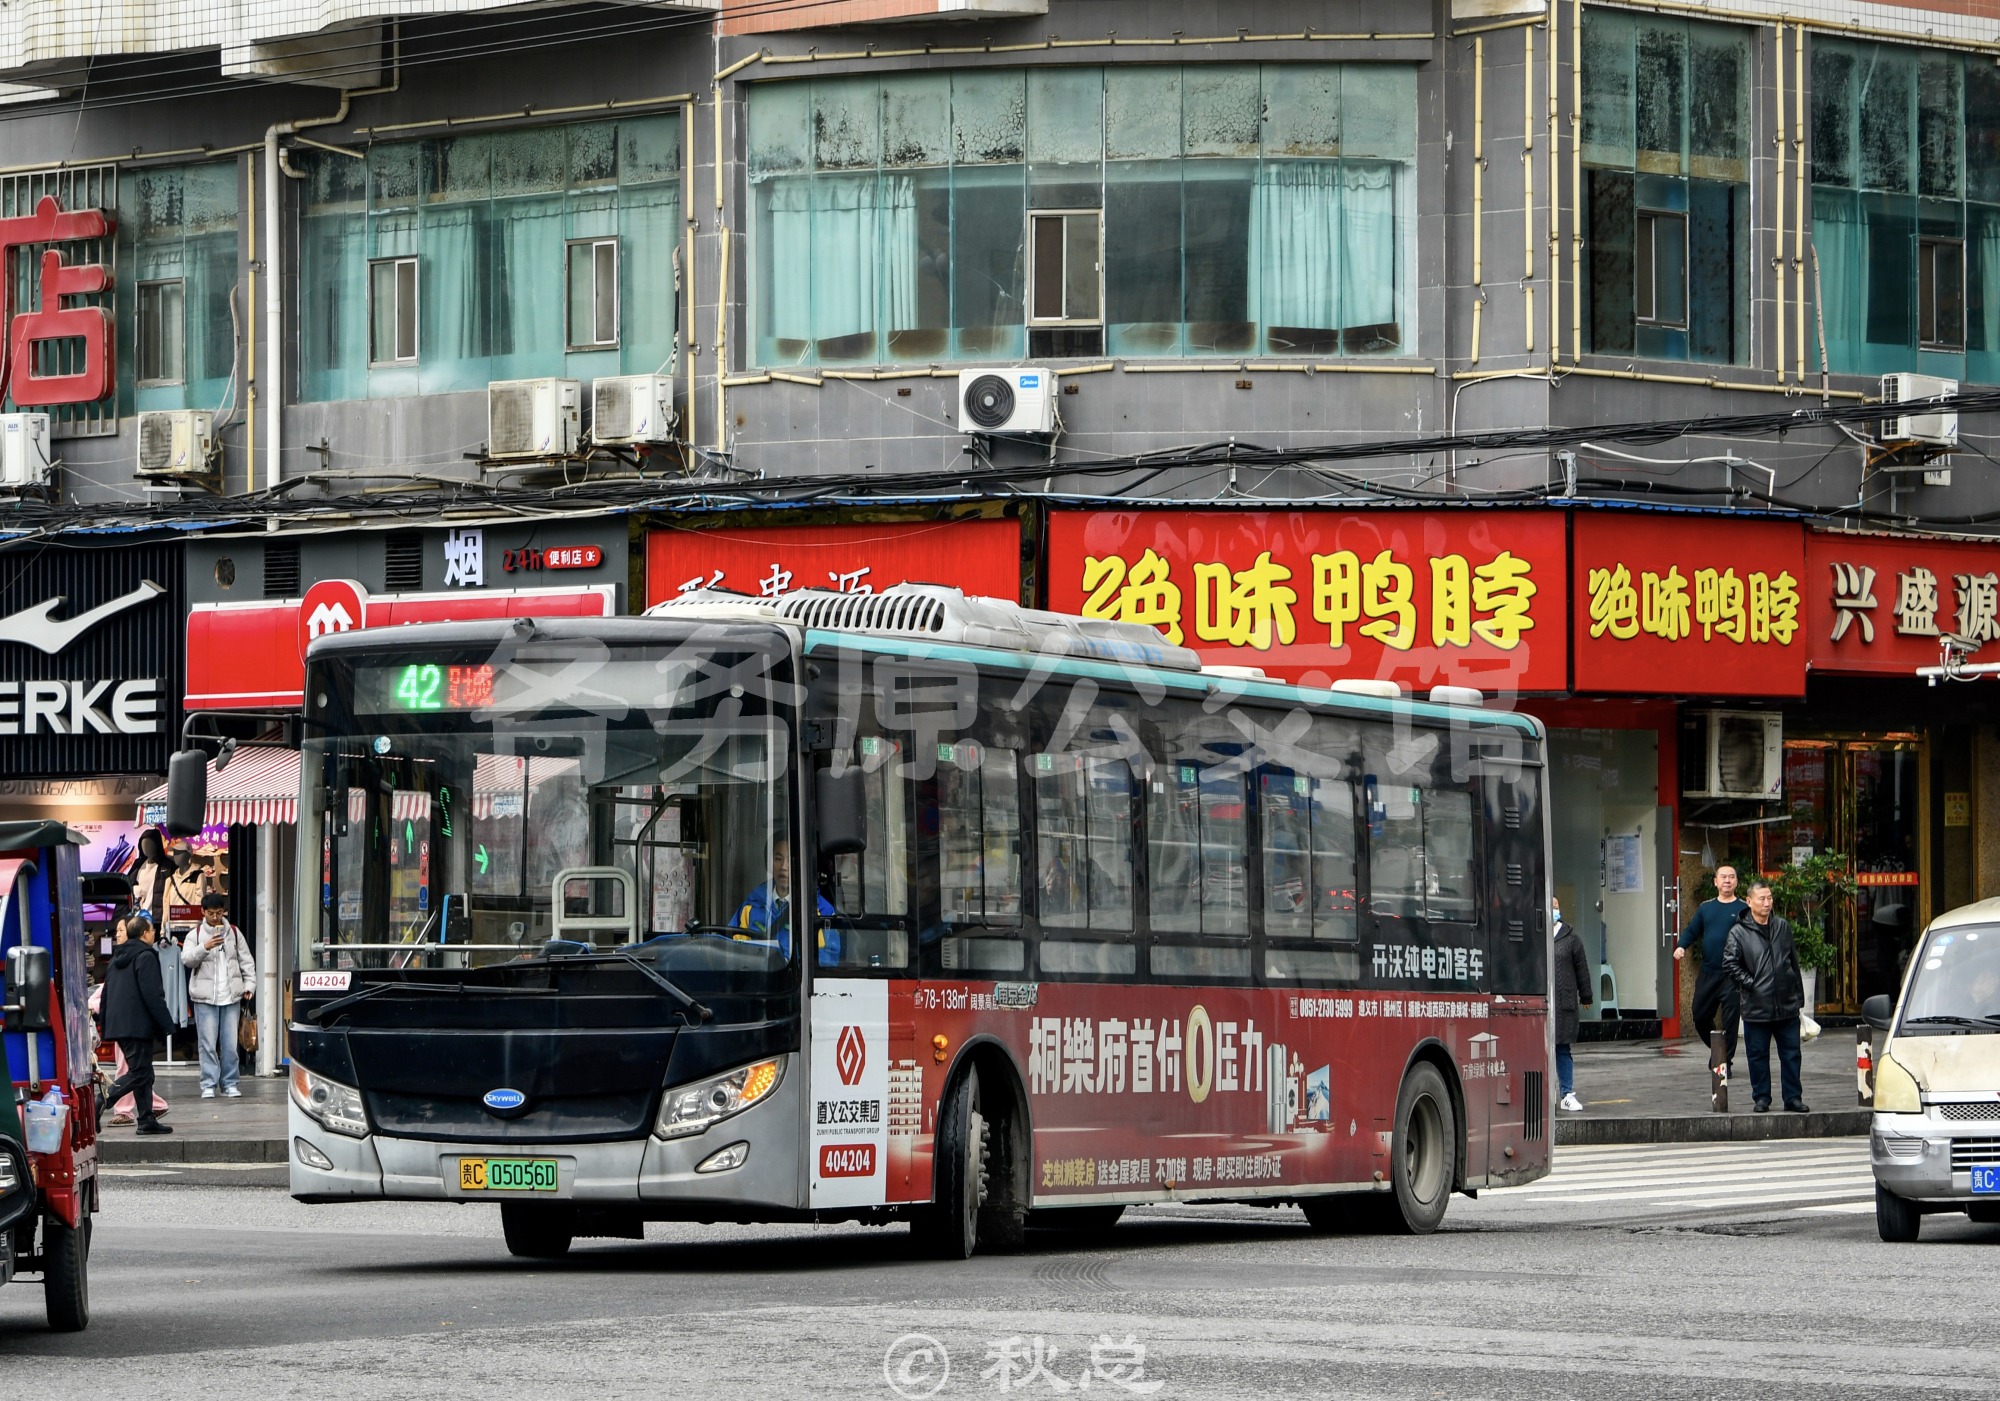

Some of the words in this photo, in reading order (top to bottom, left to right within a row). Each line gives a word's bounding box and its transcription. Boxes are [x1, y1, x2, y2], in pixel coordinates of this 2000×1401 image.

[0, 195, 108, 406] 店
[444, 529, 483, 586] 烟
[502, 549, 540, 571] 24h
[549, 550, 582, 565] 便利店
[1082, 548, 1538, 650] 绝味鸭脖
[1588, 563, 1800, 645] 绝味鸭脖
[1831, 562, 2000, 642] 兴盛源
[398, 664, 441, 709] 42
[1372, 944, 1483, 980] 开沃纯电动客车
[303, 976, 346, 986] 404204
[817, 1100, 880, 1124] 遵义公交集团
[844, 1127, 866, 1135] TRANSPORT
[825, 1149, 870, 1172] 404204
[1097, 1158, 1150, 1185] 送全屋家具
[1155, 1157, 1187, 1182] 不加钱
